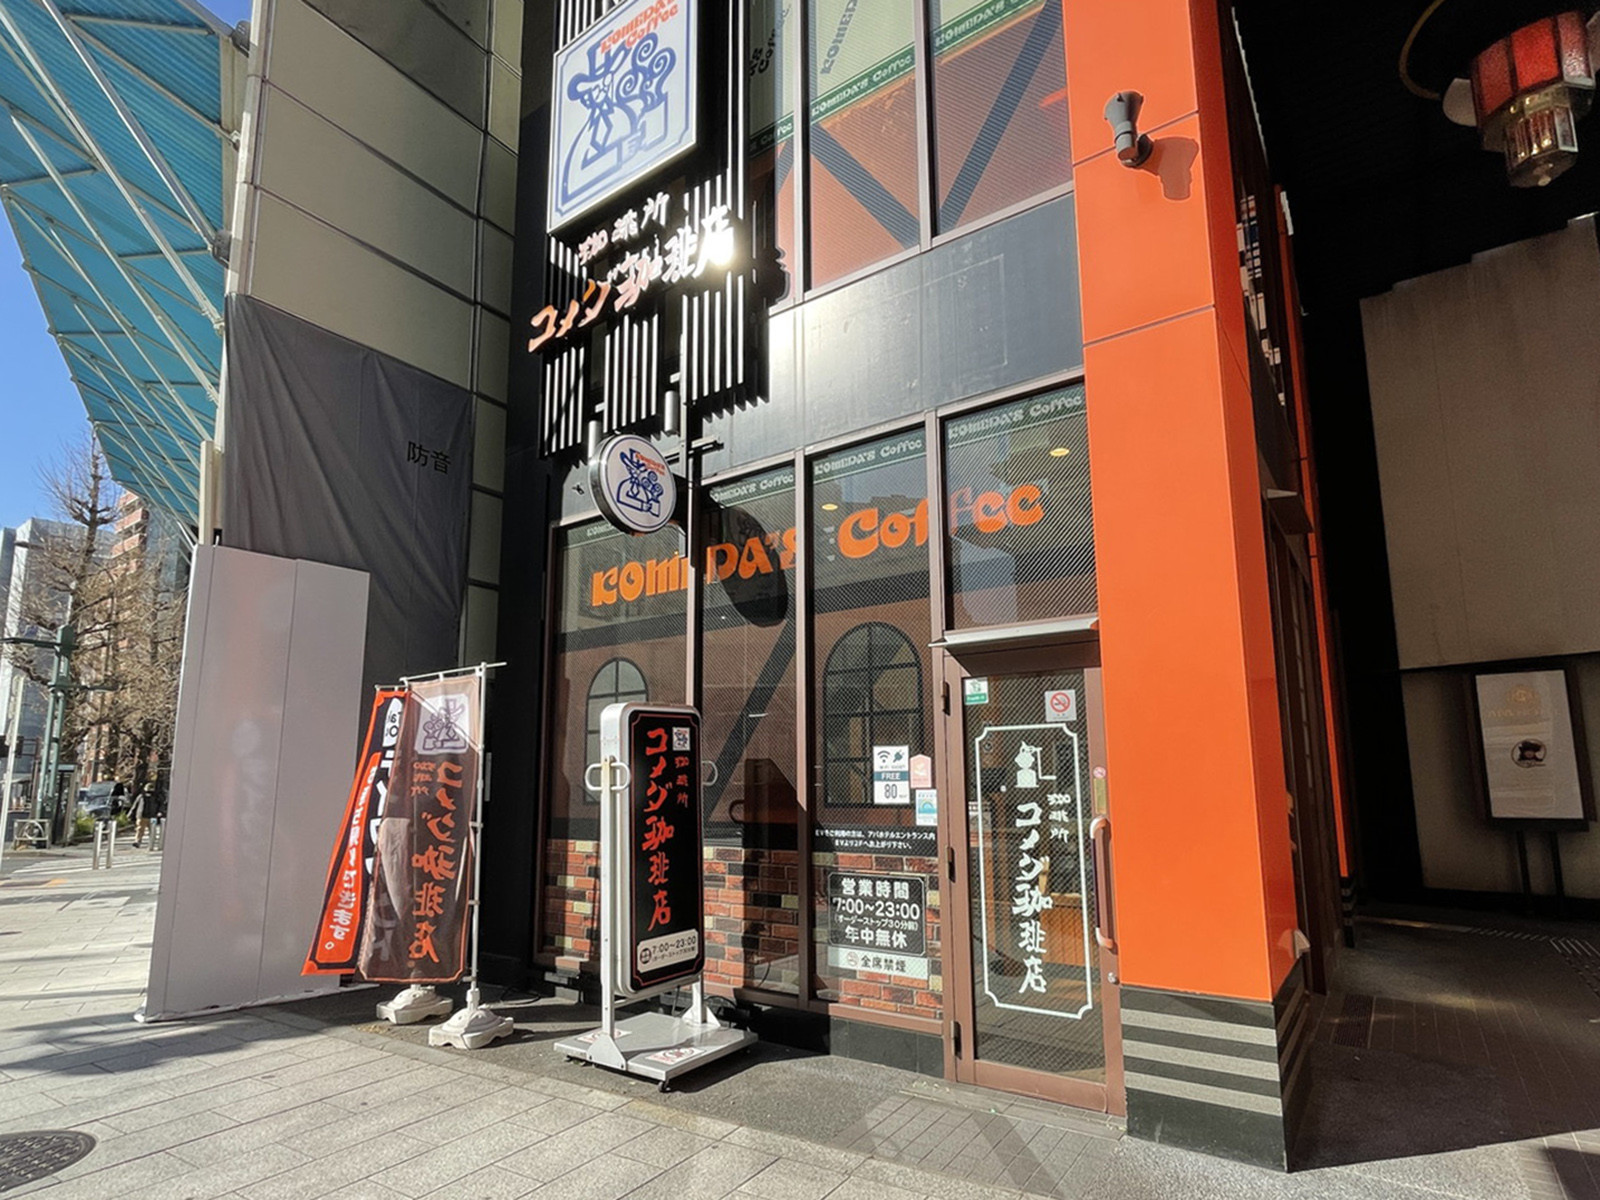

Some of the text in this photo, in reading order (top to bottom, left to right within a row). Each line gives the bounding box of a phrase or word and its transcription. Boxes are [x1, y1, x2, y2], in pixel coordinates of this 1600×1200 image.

[407, 440, 452, 475] 防音
[881, 772, 901, 780] FREE
[884, 783, 898, 799] 80
[641, 727, 676, 932] コメダ珈琲店
[841, 877, 910, 900] 営業時間
[1012, 801, 1055, 994] コメダ珈琲店
[844, 925, 908, 949] 年中無休
[860, 954, 907, 973] 全席禁煙
